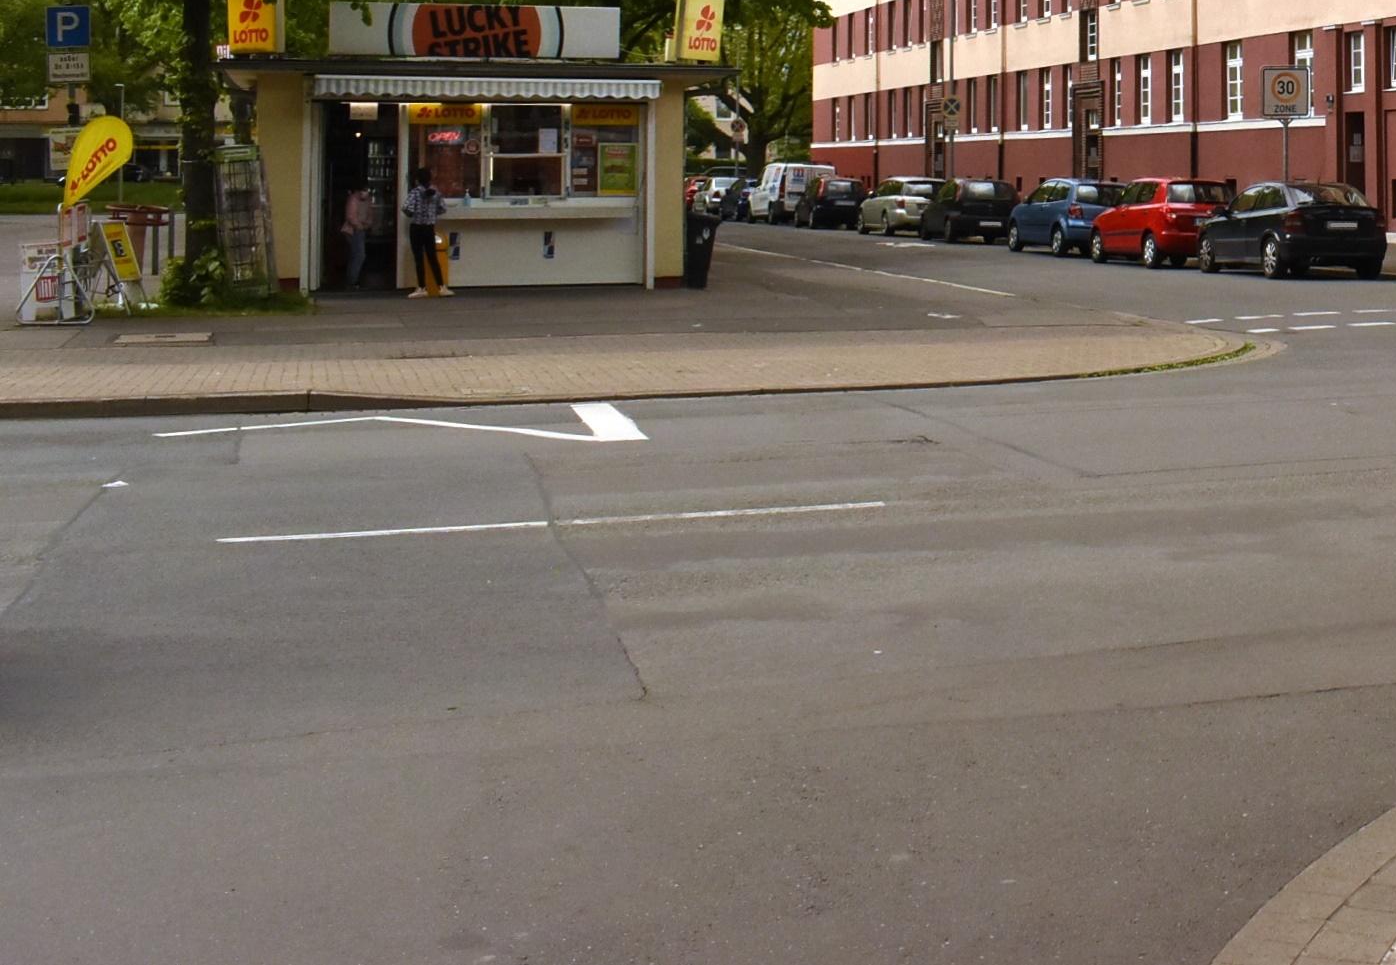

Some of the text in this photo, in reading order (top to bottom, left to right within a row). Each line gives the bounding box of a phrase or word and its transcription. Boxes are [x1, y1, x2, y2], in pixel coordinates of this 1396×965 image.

[56, 11, 80, 42] P
[429, 5, 521, 38] LUCKY
[233, 28, 269, 44] LOTTO
[427, 29, 531, 57] STRIKE
[688, 36, 717, 51] LOTTO
[1277, 80, 1295, 95] 30
[435, 107, 475, 118] LOTTO
[592, 108, 632, 119] LOTTO
[1274, 104, 1297, 113] ZONE
[428, 131, 462, 142] OPEN
[81, 137, 117, 180] LOTTO
